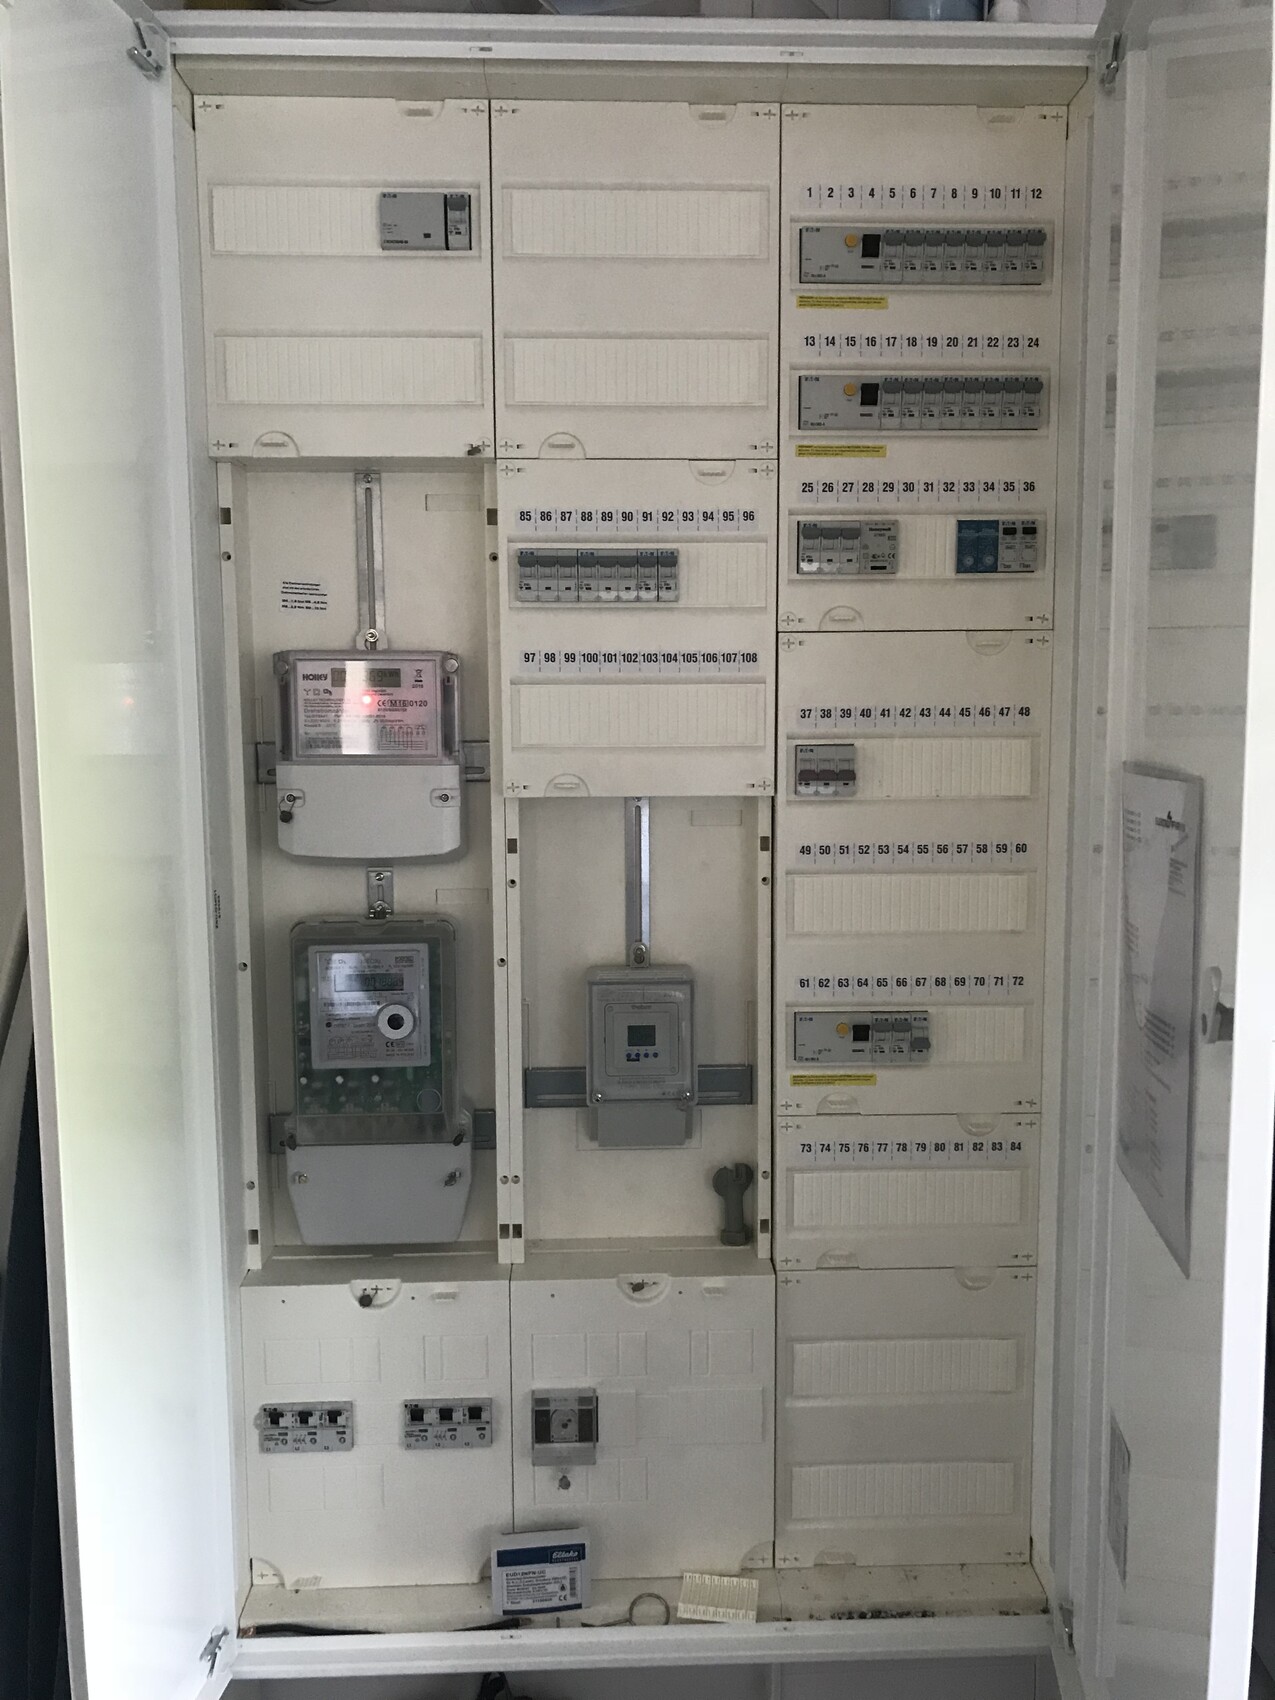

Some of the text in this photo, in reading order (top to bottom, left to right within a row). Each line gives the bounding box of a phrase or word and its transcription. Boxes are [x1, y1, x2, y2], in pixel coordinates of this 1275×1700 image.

[806, 187, 1043, 199] 1 2 3 4 5 6 7 8 9 10 11 12
[805, 336, 1040, 348] 13 14 15 16 17 18 19 20 21 22 23 24
[801, 481, 1036, 493] 25 26 27 28 29 30 31 32 33 34 35 36
[519, 511, 755, 522] 85 86 87 88 89 90 91 92 93 94 95 96
[523, 652, 757, 664] 97 98 99 100 101 102 103 104 105 106 107 108
[800, 706, 1031, 719] 37 38 39 40 41 42 43 44 45 46 47 48
[799, 843, 1028, 856] 49 50 51 52 53 54 55 56 57 58 59 60
[799, 976, 1024, 989] 61 62 63 64 65 66 67 68 69 70 71 72
[800, 1141, 1022, 1153] 73 74 75 76 77 78 79 80 81 82 83 84
